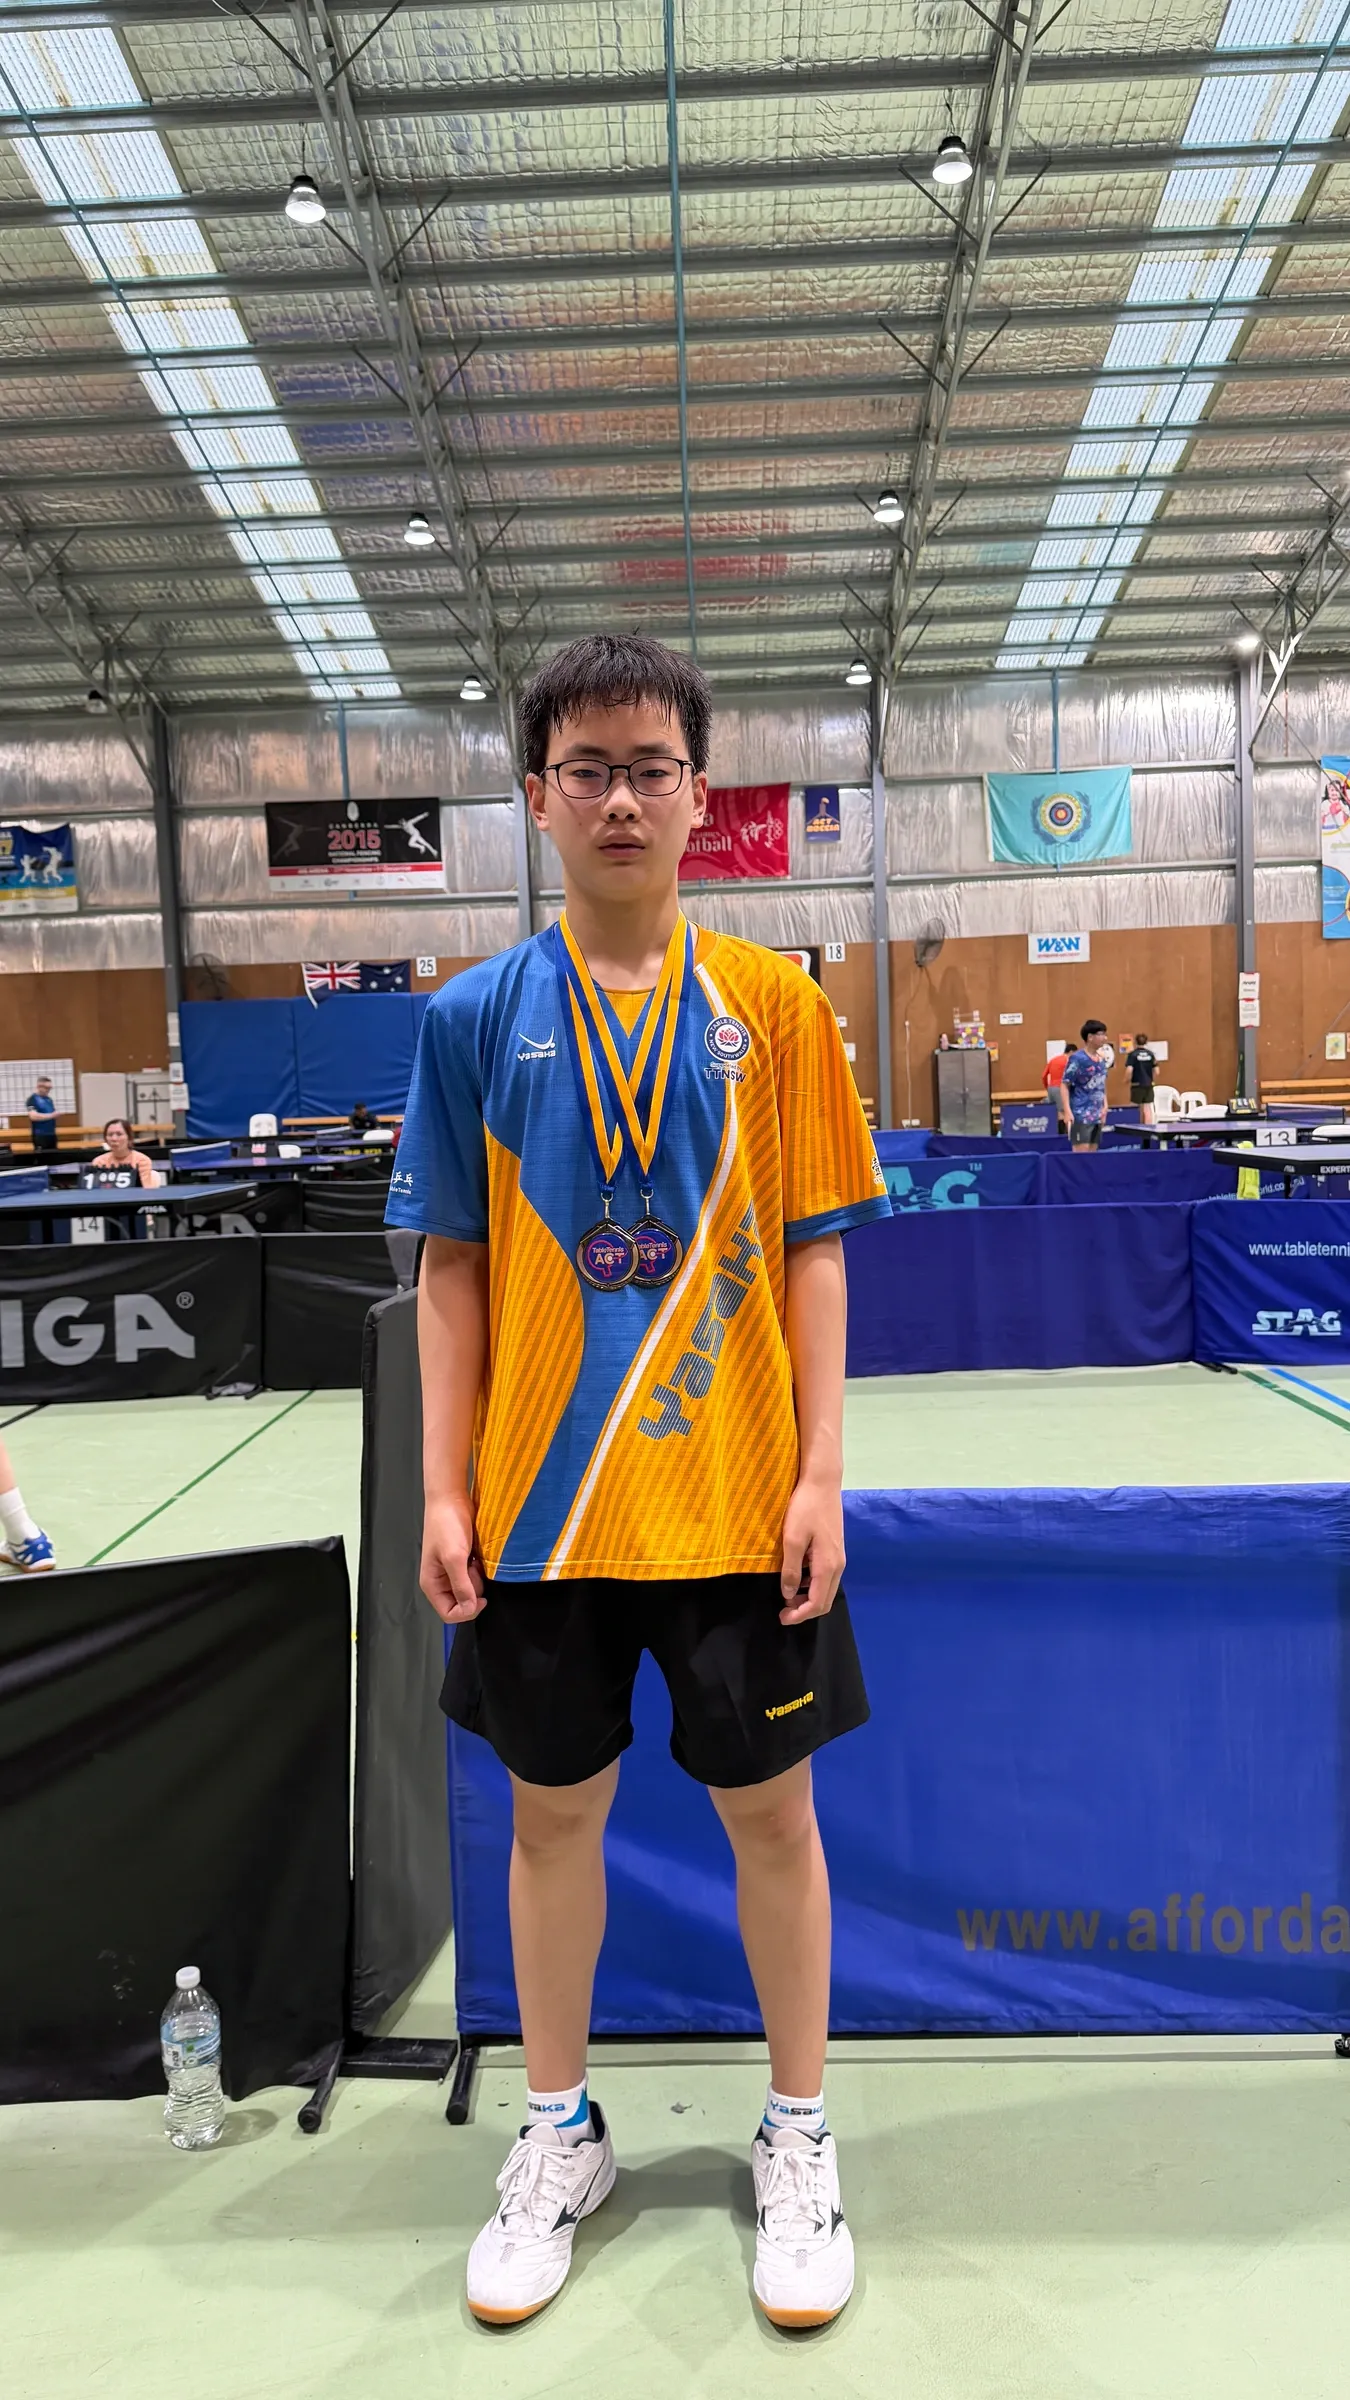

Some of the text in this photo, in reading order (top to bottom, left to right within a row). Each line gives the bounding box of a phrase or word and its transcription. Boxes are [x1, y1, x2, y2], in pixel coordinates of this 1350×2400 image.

[327, 829, 381, 850] 2015
[1037, 936, 1080, 952] W&W
[829, 945, 842, 960] 18
[420, 959, 434, 974] 25
[710, 1018, 747, 1037] TABLE TENNIS
[709, 1039, 747, 1059] NEW SOUTH WALES
[704, 1068, 747, 1083] TTNSW
[1263, 1131, 1290, 1146] 13
[1320, 1165, 1350, 1174] EXPERT
[78, 1216, 99, 1233] 14
[595, 1252, 625, 1265] ACT
[640, 1247, 668, 1260] ACT
[1252, 1308, 1341, 1336] STAG
